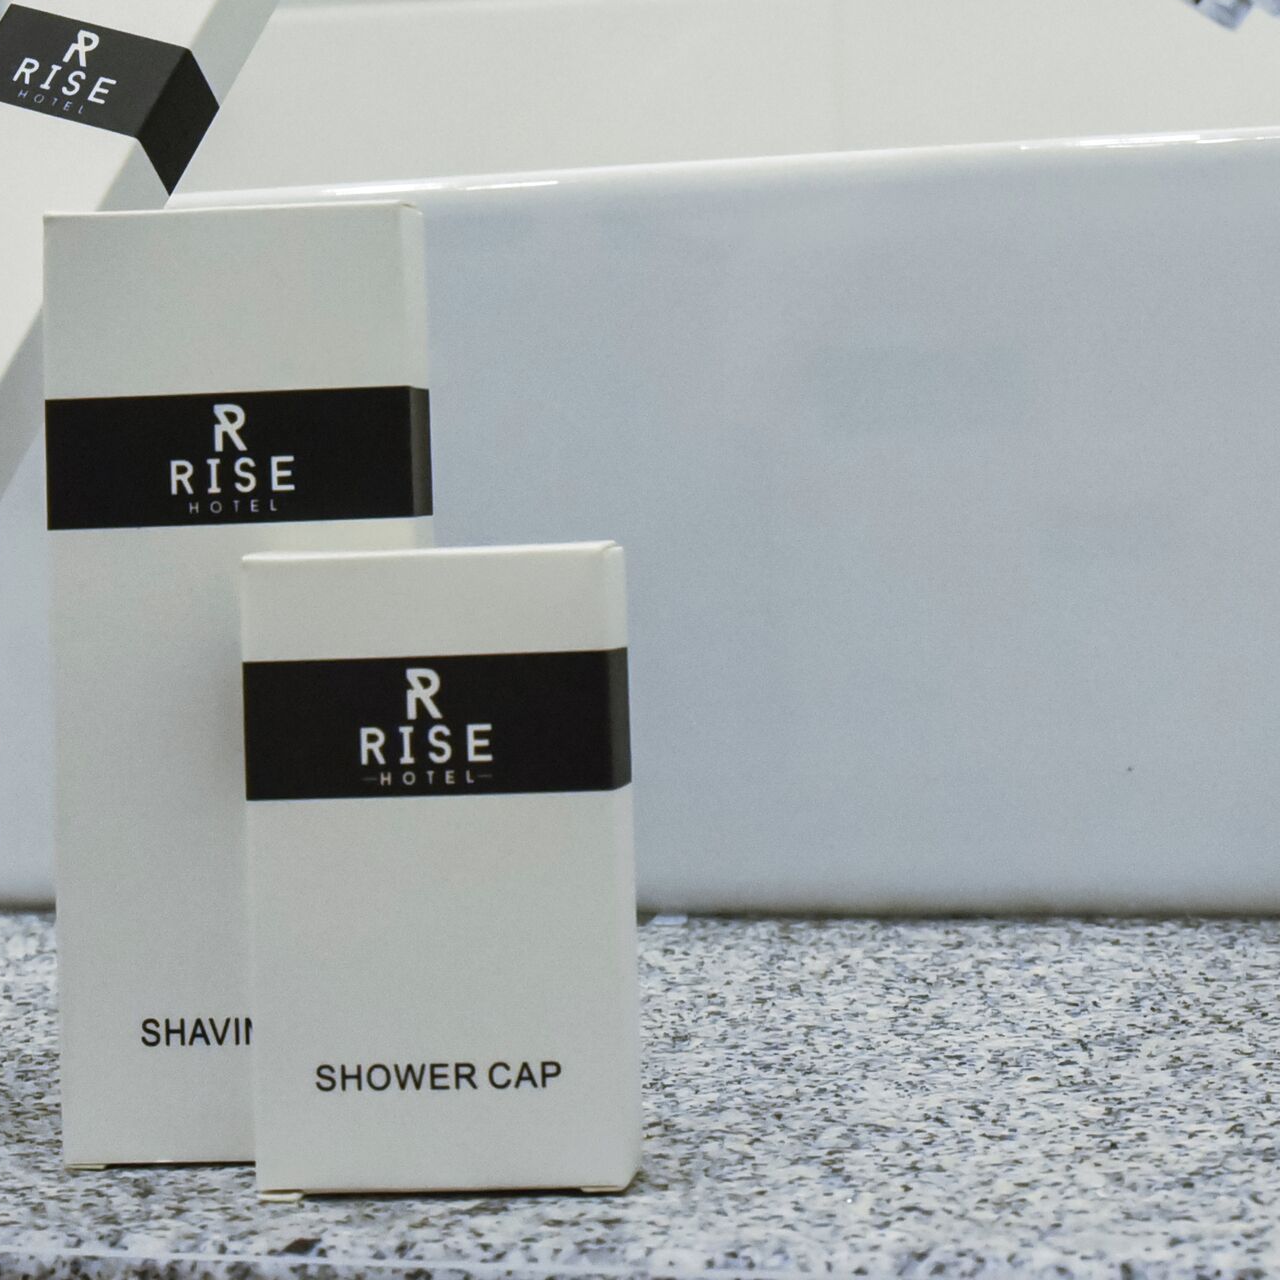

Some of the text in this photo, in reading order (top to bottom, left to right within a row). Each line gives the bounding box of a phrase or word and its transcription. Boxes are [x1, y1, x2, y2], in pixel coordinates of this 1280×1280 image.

[62, 29, 100, 68] R
[12, 57, 117, 105] RISE
[17, 89, 85, 115] HOTEL
[213, 403, 248, 452] R
[170, 455, 296, 496] RISE
[188, 499, 278, 514] HOTEL
[405, 668, 443, 720] R
[359, 723, 493, 766] RISE
[379, 770, 475, 786] HOTEL
[140, 1017, 253, 1047] SHAVI
[315, 1060, 563, 1092] SHOWER CAP
